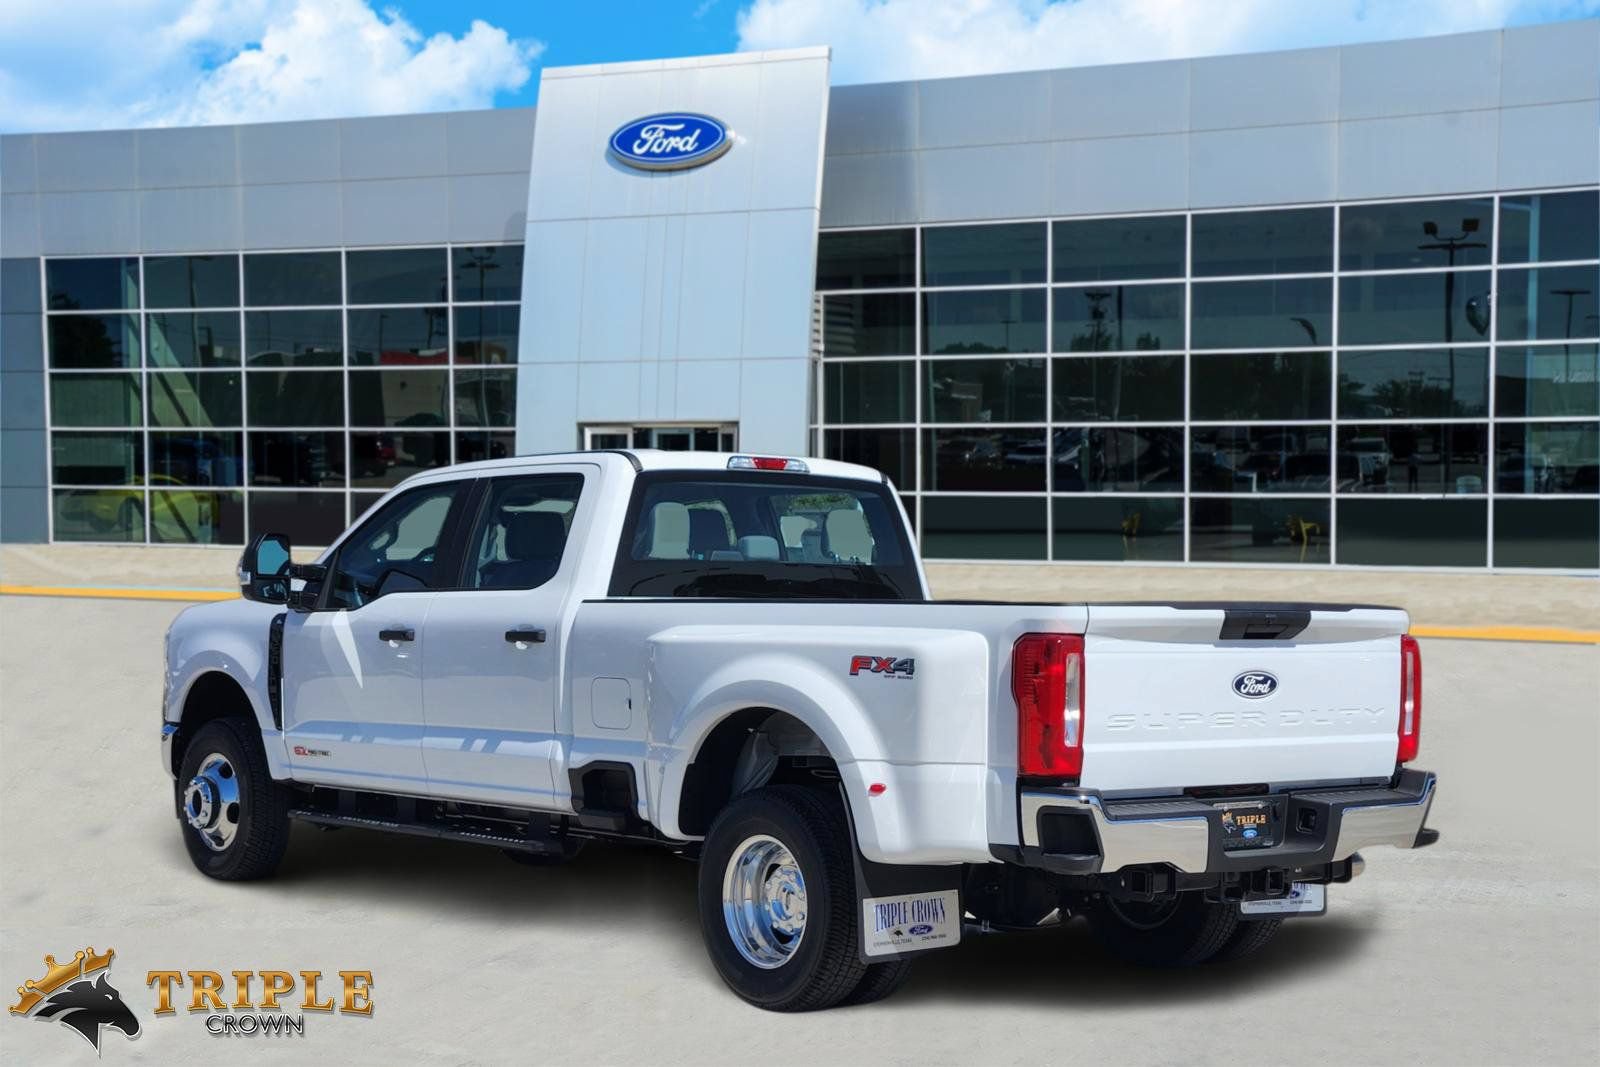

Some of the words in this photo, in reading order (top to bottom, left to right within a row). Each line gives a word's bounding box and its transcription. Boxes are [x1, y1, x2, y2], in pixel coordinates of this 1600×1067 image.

[632, 123, 702, 155] Ford
[849, 655, 915, 676] FX4
[1240, 675, 1271, 694] Ford
[1107, 711, 1267, 732] SUPER
[1280, 707, 1385, 726] DUTY
[1235, 814, 1267, 826] TRIPLE
[874, 902, 909, 932] TRIPLE
[911, 897, 946, 924] CROWN
